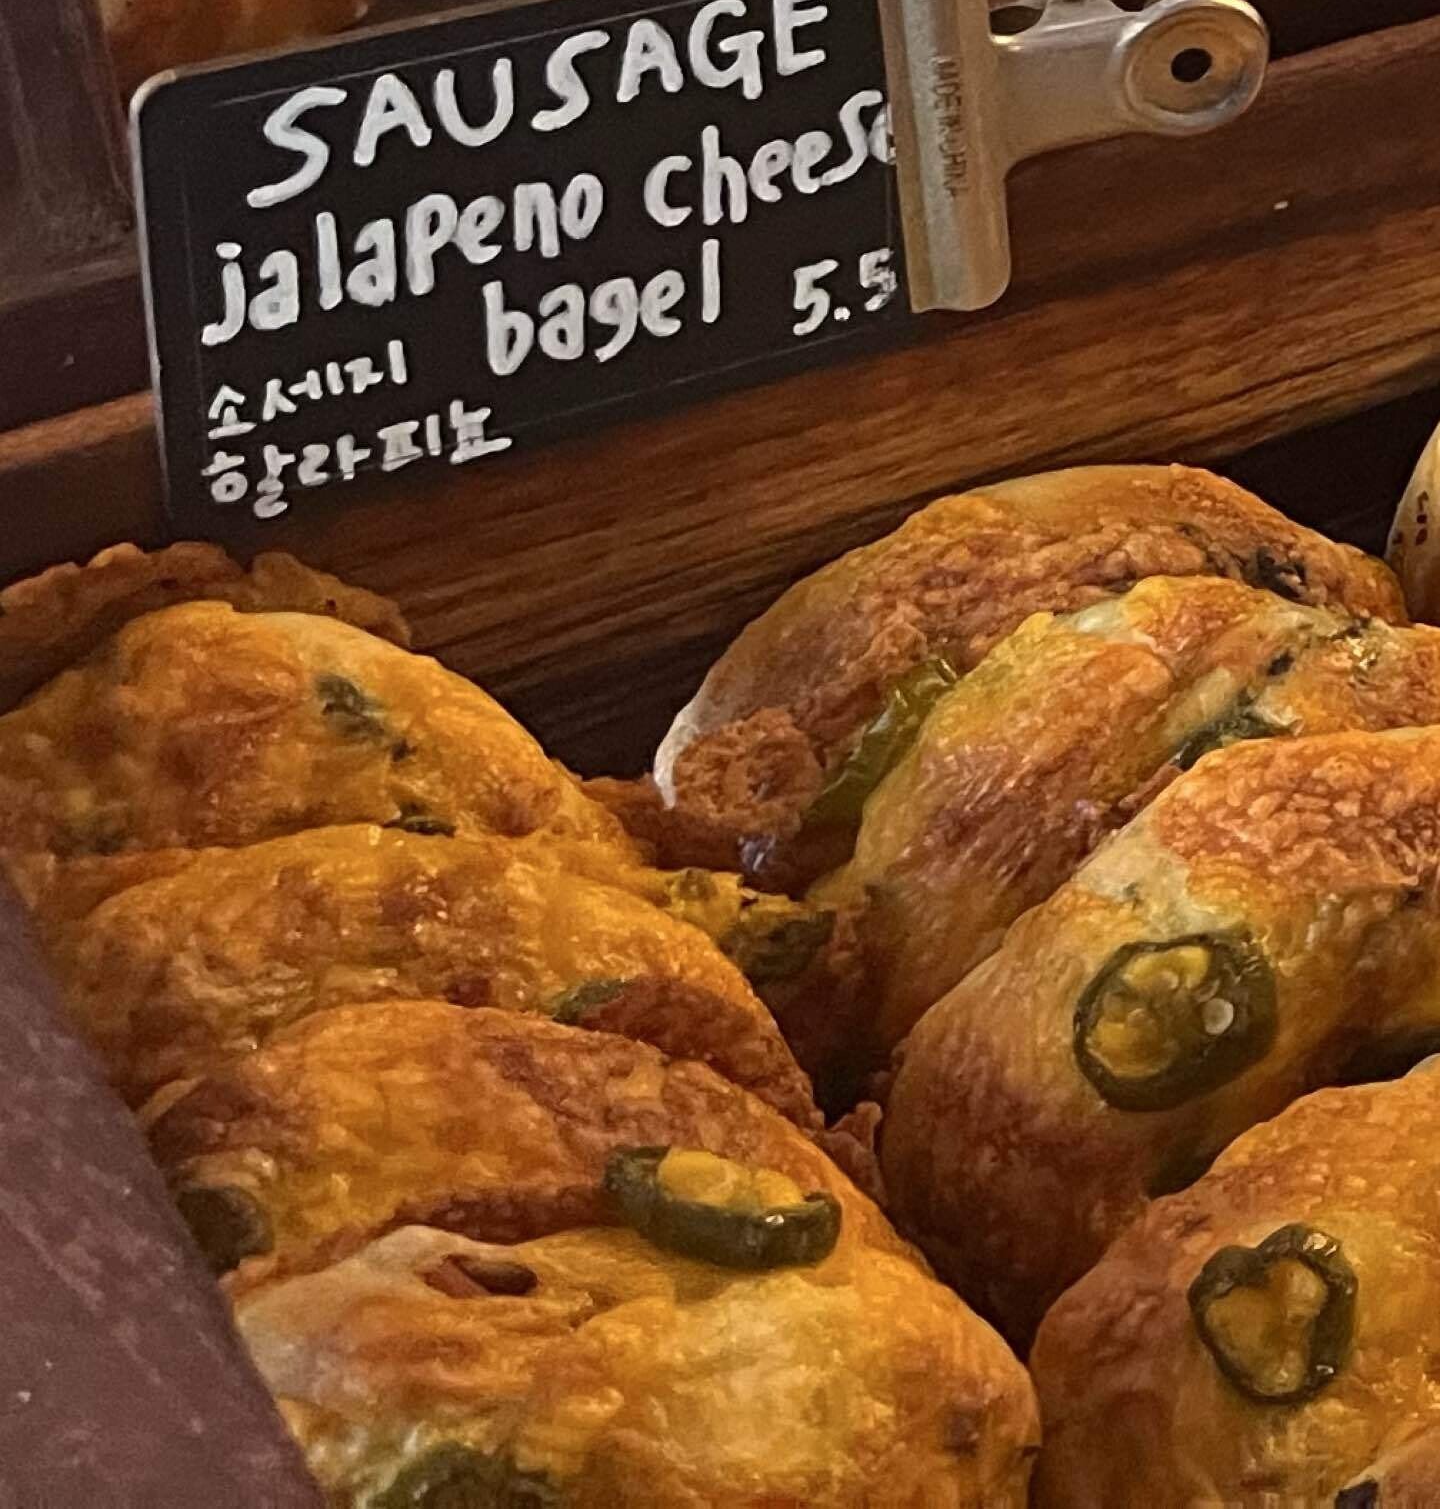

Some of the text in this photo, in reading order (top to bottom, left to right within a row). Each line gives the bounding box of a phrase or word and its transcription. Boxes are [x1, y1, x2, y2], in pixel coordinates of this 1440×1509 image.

[643, 89, 897, 227] cheese
[483, 237, 898, 376] bagel 5.5
[207, 339, 408, 439] 소세지
[201, 399, 513, 519] 할라피뇨
